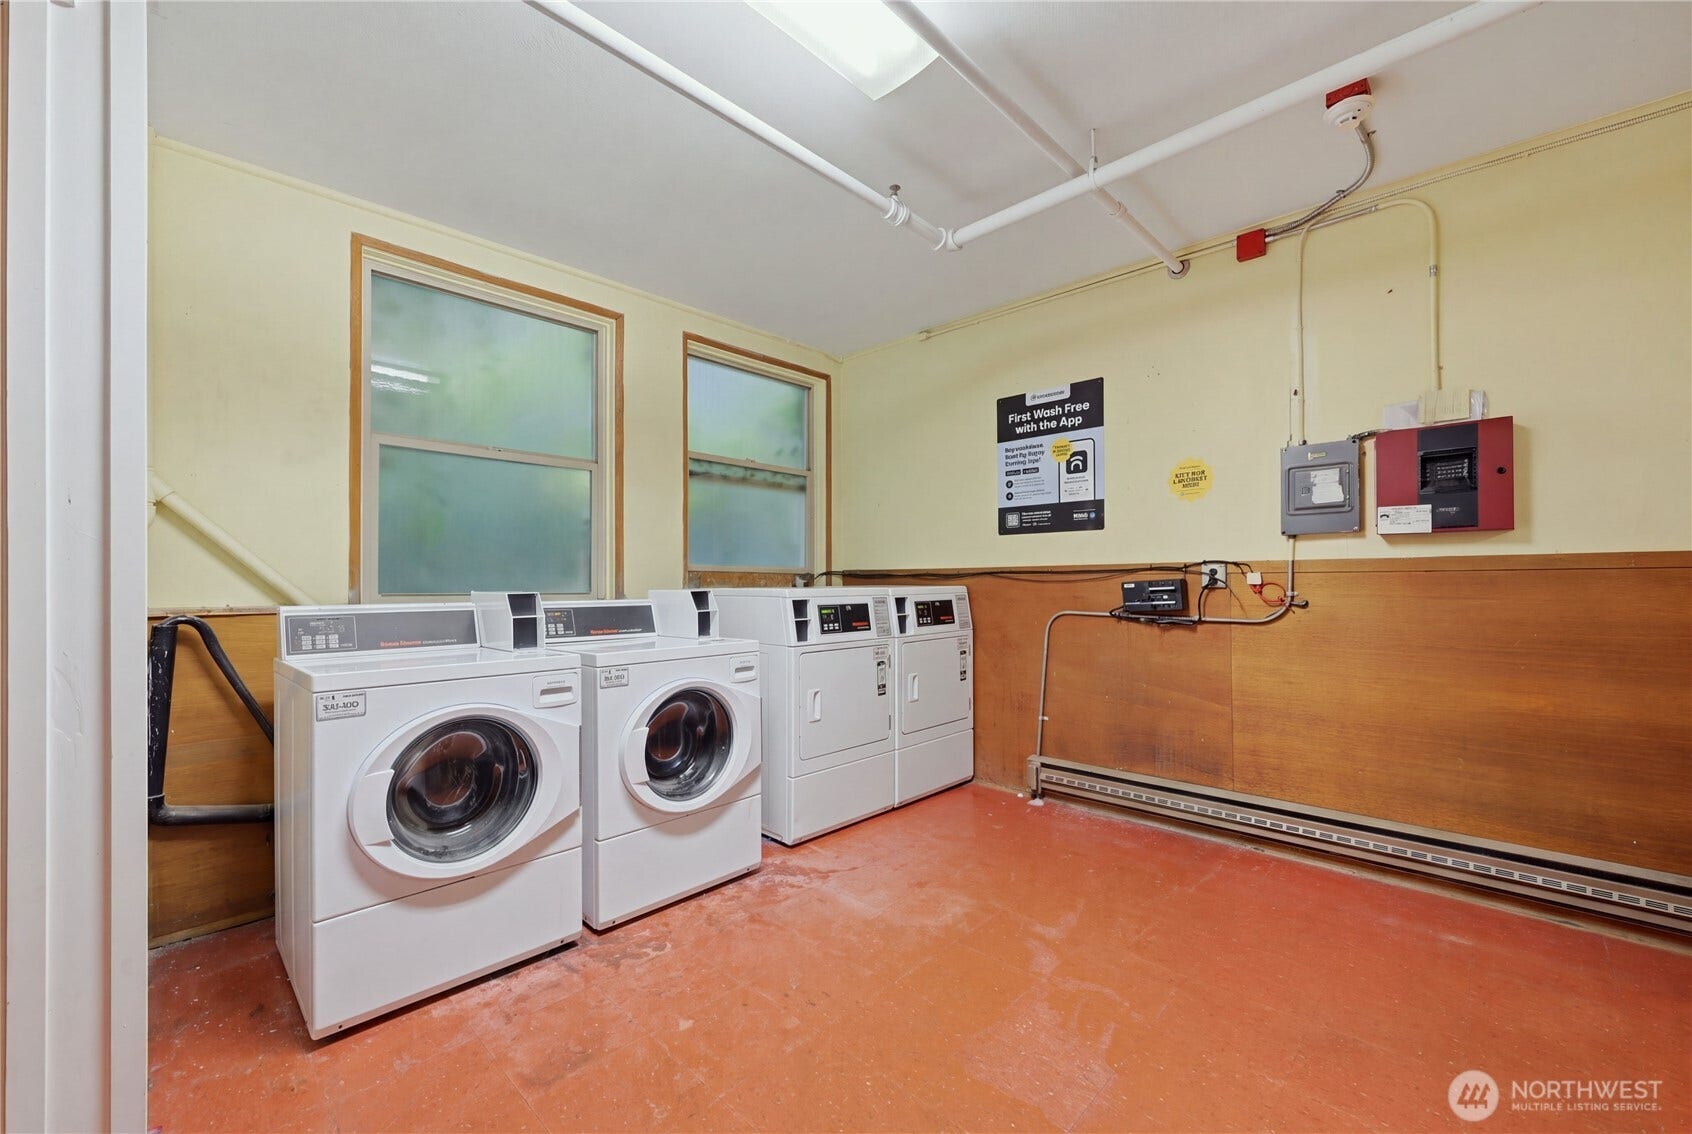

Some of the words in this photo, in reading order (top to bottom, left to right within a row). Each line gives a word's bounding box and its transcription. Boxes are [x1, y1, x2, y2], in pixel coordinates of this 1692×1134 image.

[1008, 411, 1031, 424] First
[1033, 405, 1062, 419] Wash
[1064, 401, 1090, 414] Free
[1015, 421, 1037, 434] with
[1039, 419, 1057, 430] the
[1059, 415, 1083, 428] App
